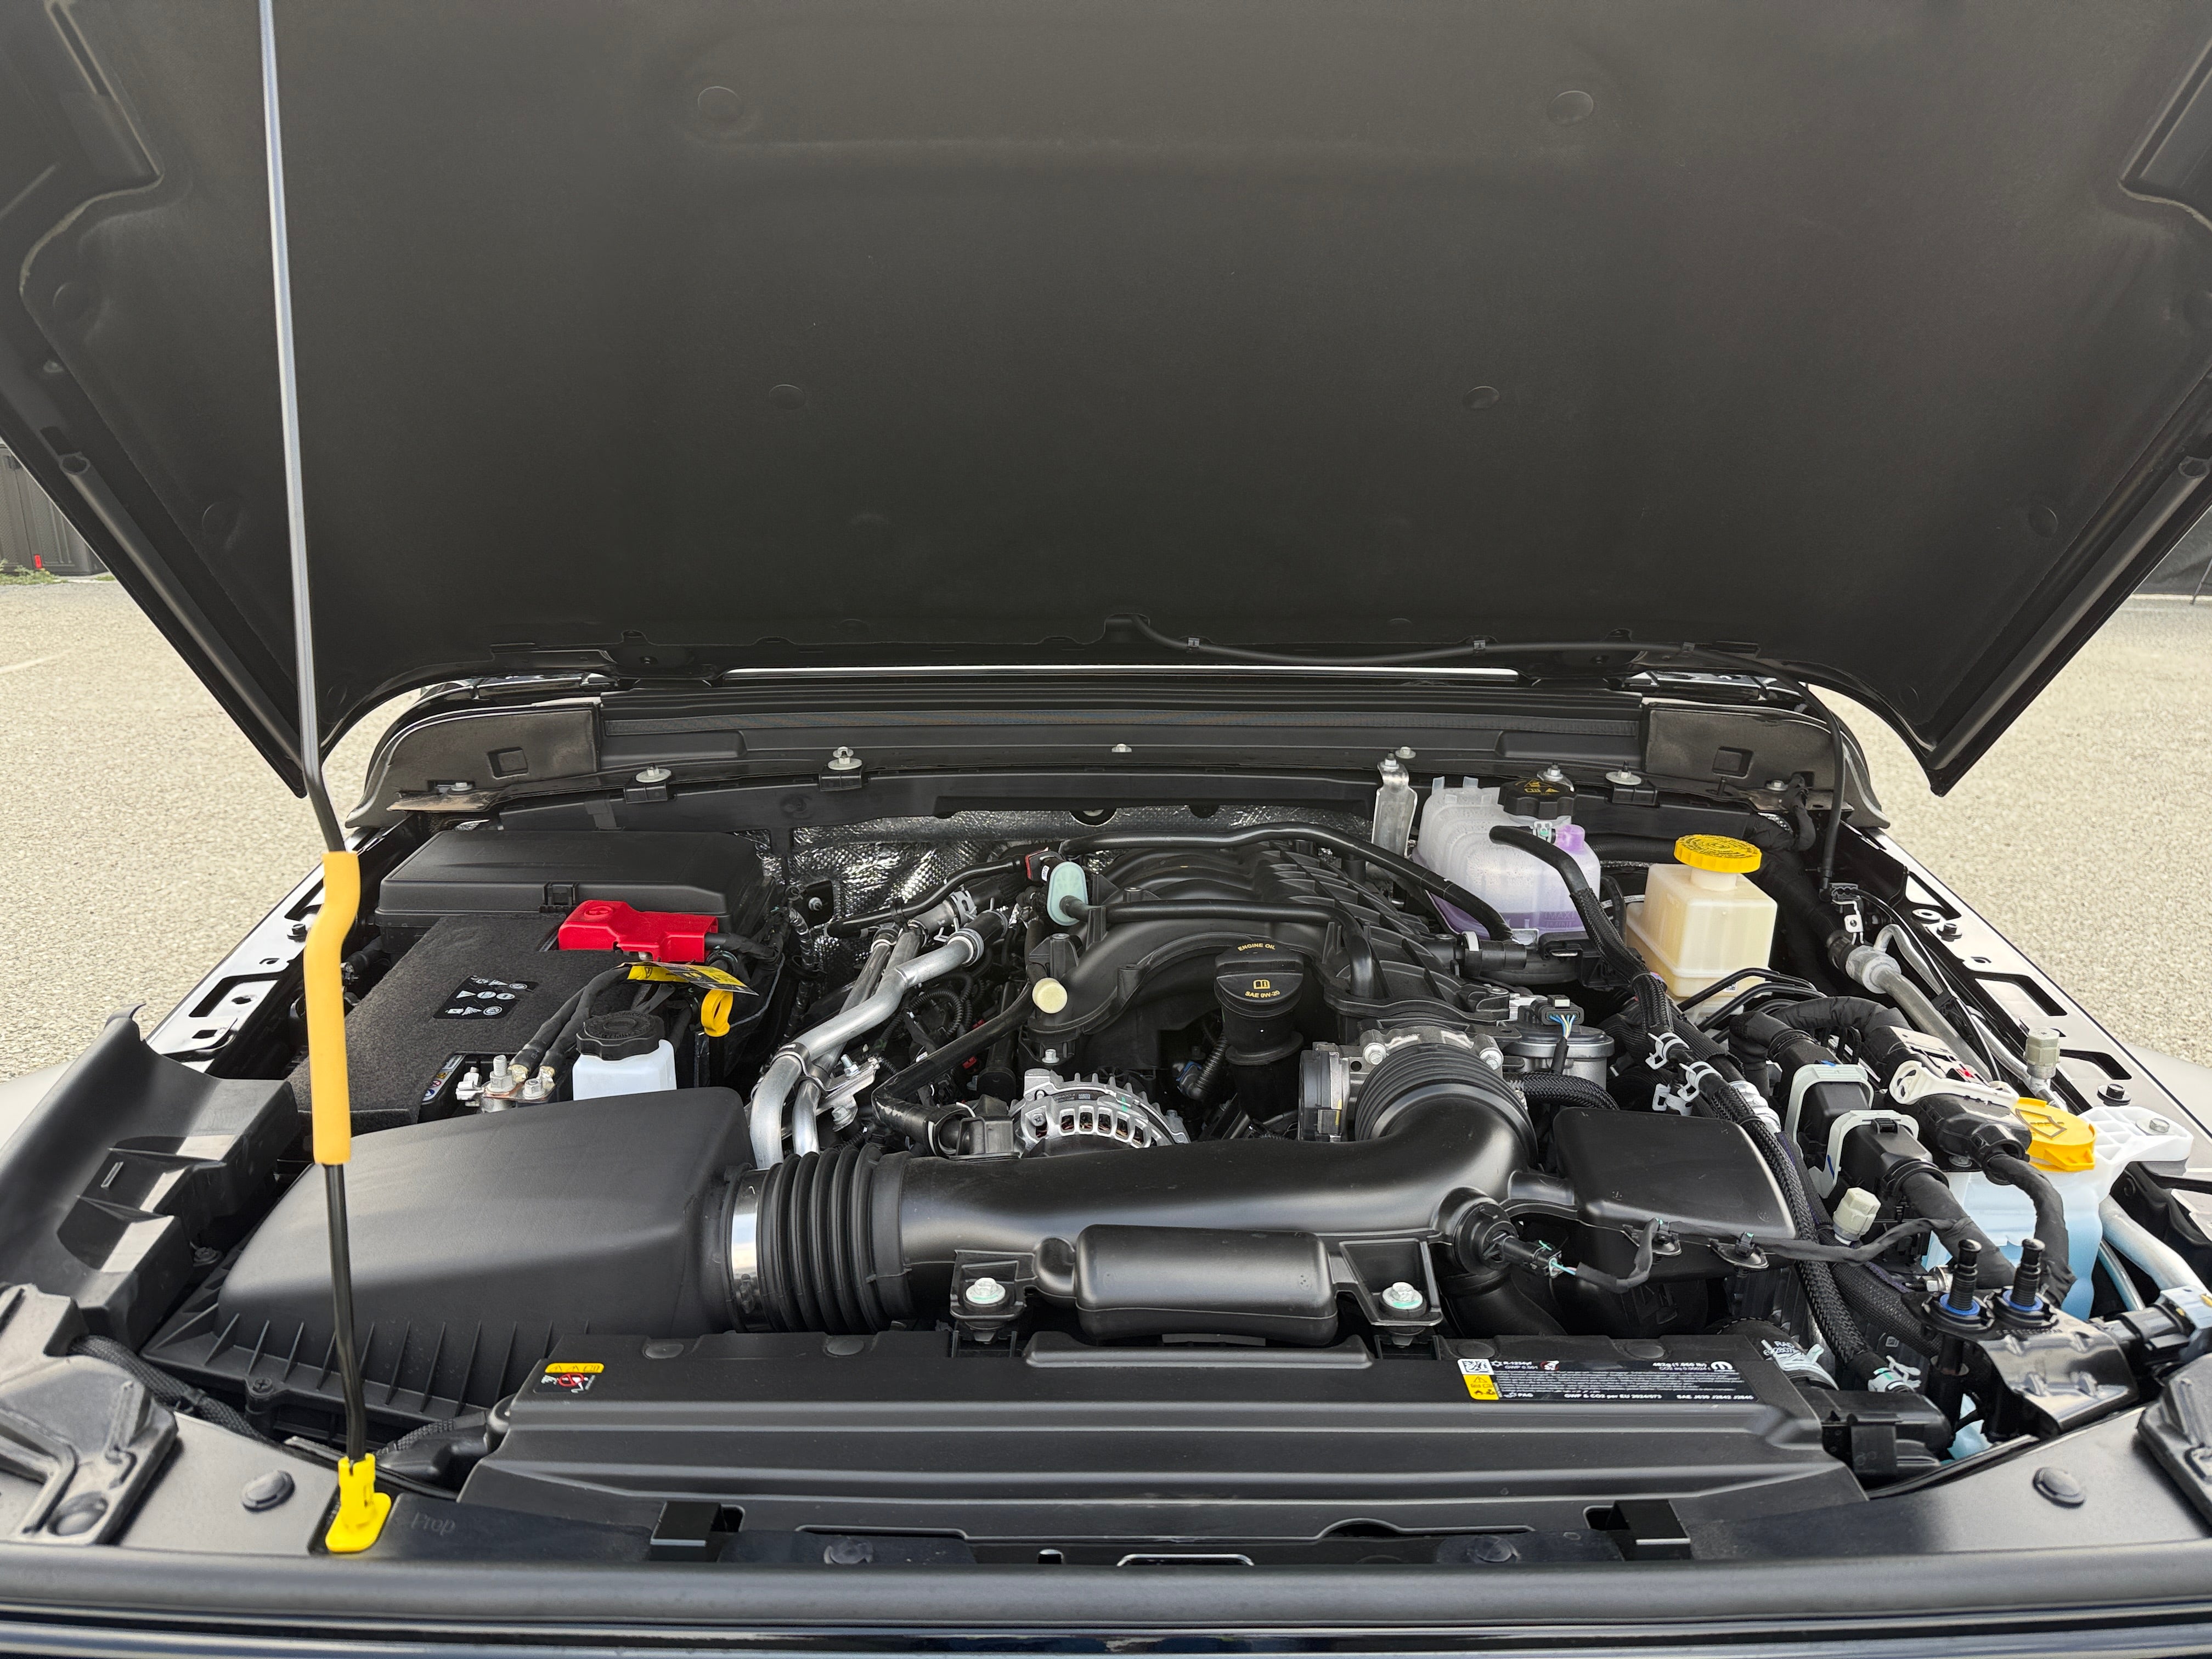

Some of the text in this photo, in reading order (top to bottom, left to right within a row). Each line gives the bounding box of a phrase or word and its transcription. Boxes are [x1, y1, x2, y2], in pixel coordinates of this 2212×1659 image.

[1237, 943, 1263, 951] ENGINE
[1260, 990, 1280, 998] 0W-20
[411, 1511, 456, 1536] Prop
